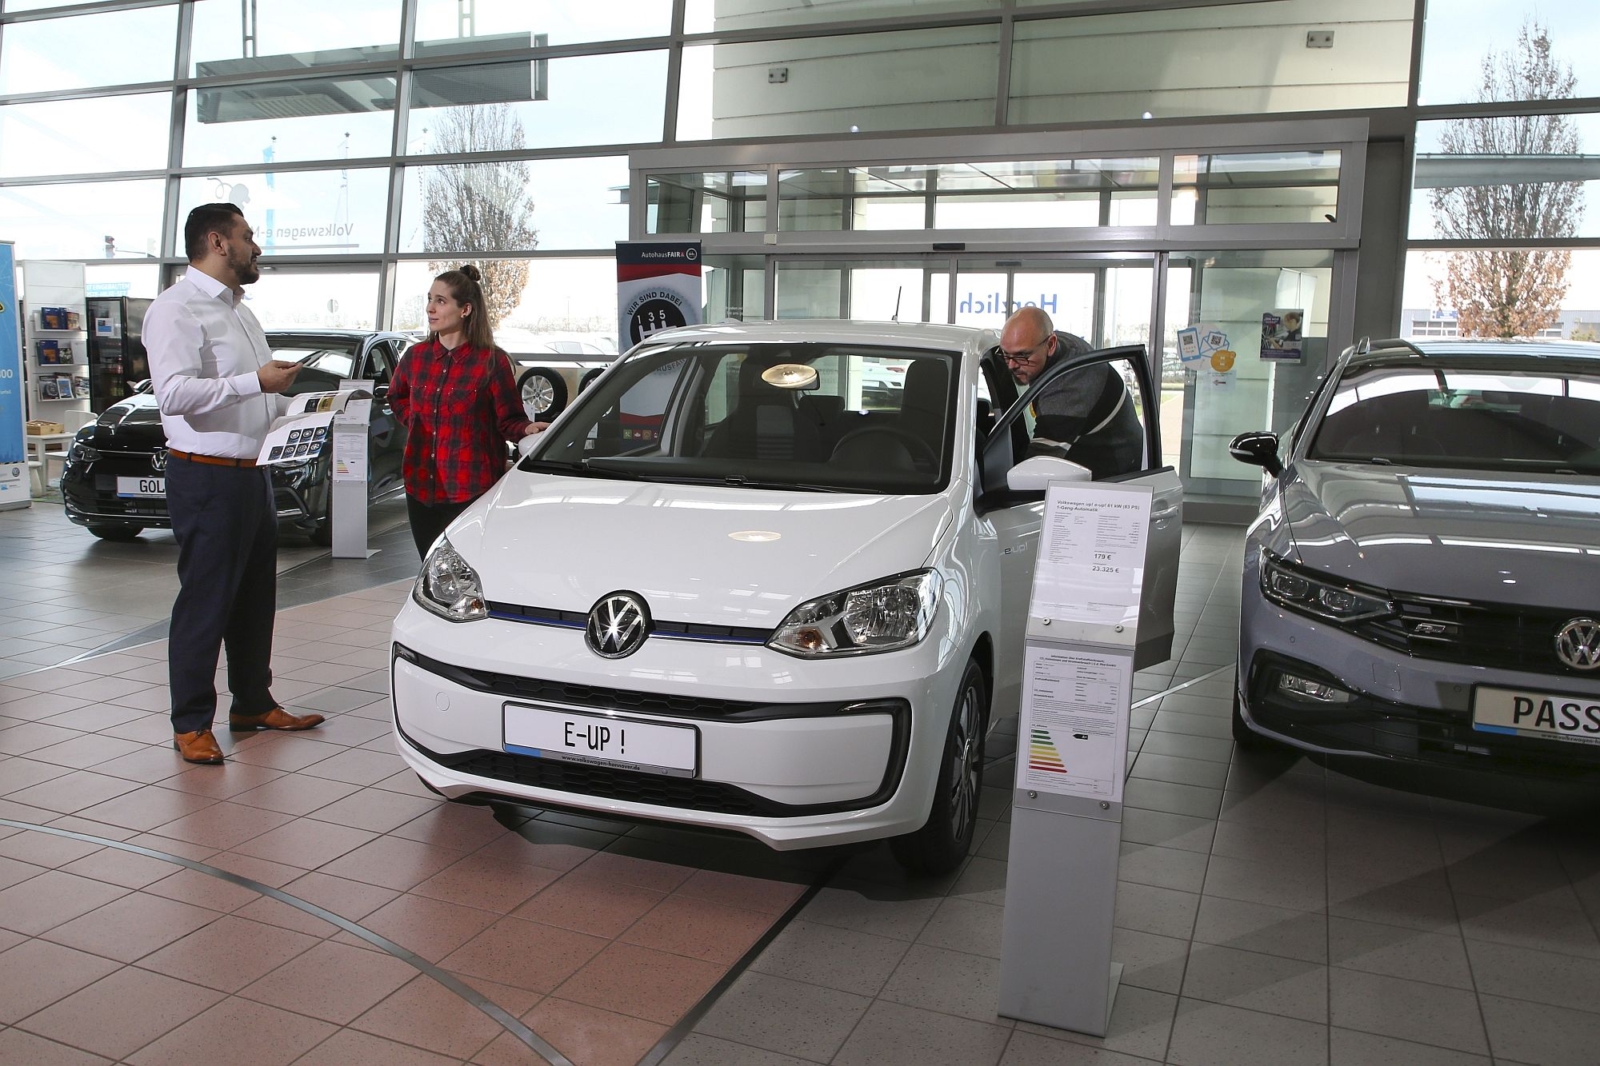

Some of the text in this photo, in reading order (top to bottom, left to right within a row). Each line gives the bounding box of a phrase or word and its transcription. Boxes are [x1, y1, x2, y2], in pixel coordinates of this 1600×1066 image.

[627, 291, 683, 317] WIR SIND DABEI
[648, 312, 655, 322] 3
[659, 309, 666, 320] 5
[139, 479, 165, 494] GOL
[564, 721, 610, 751] E-UP
